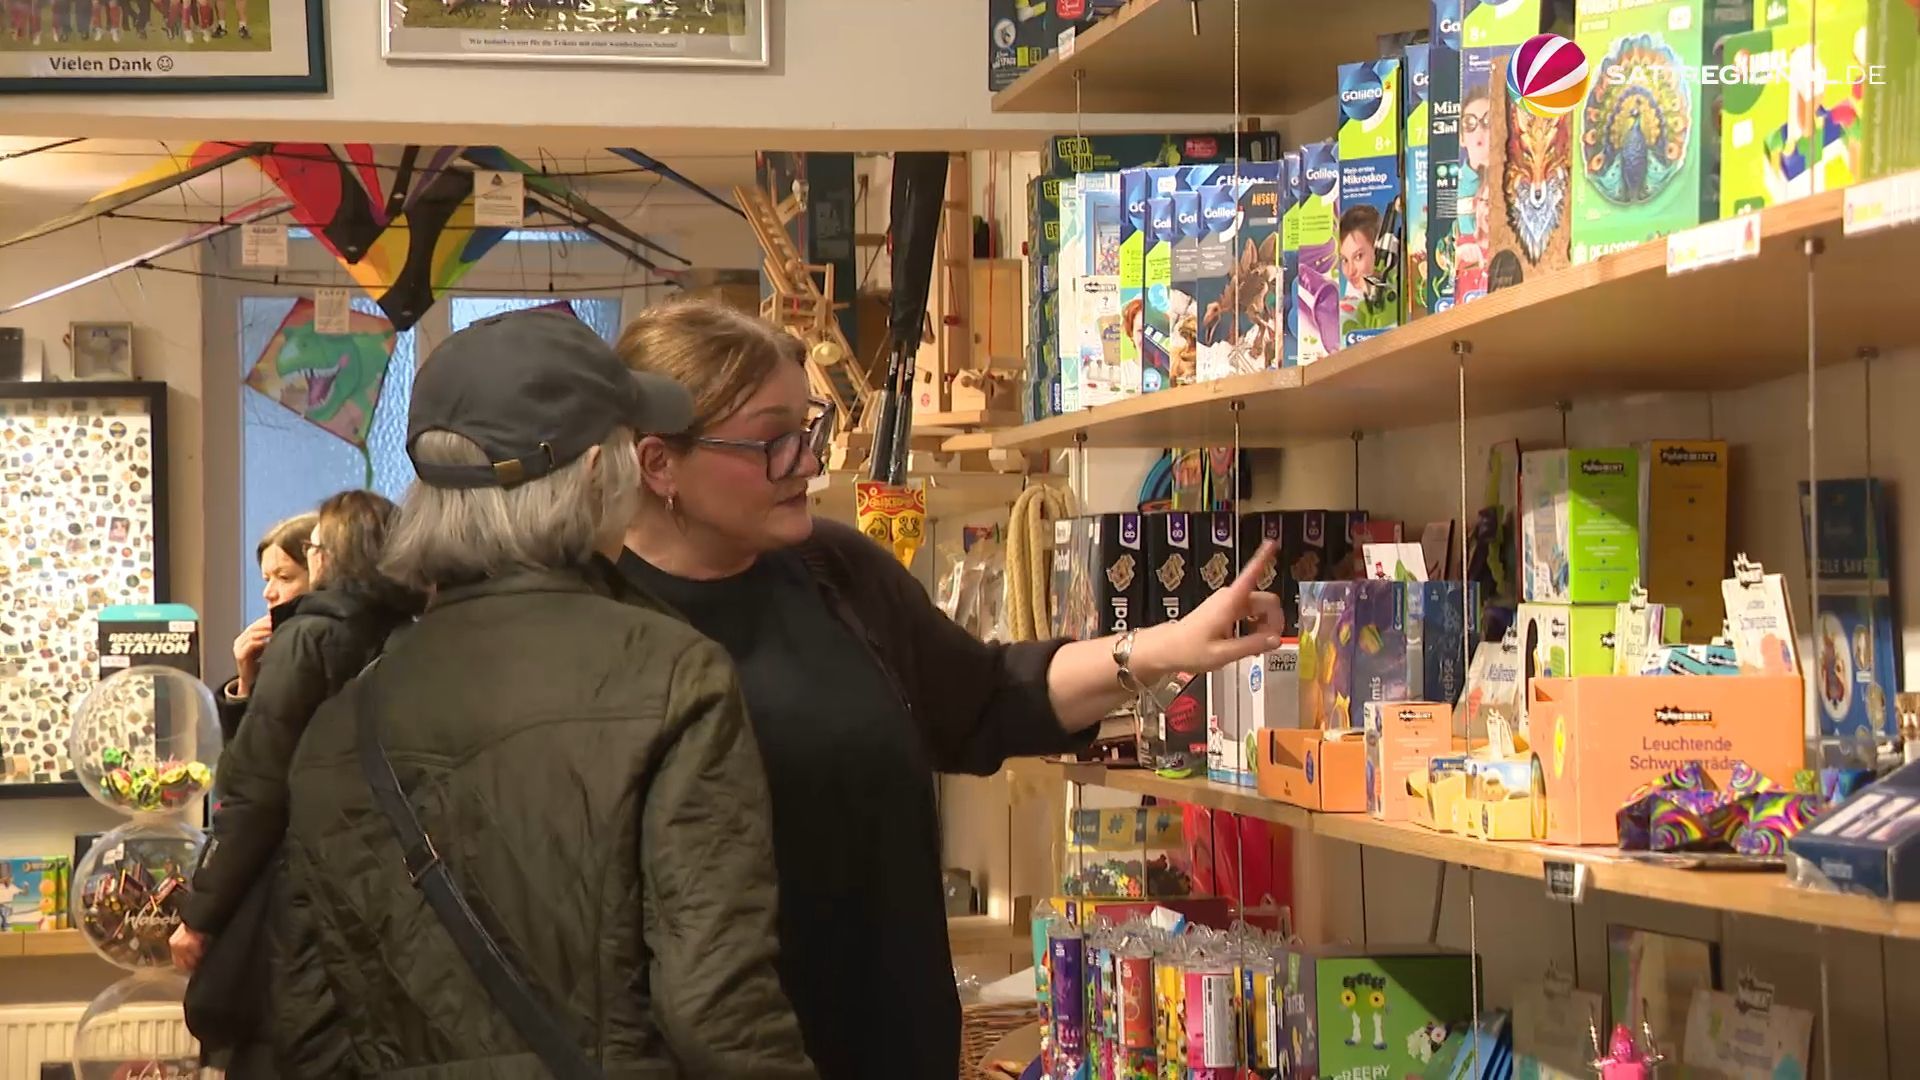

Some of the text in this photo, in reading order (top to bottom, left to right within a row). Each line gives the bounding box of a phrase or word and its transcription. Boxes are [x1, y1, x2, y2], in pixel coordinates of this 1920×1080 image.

[49, 57, 152, 71] Vielen Dank
[1341, 87, 1383, 103] Galileo
[1059, 140, 1088, 156] GECO
[1374, 136, 1392, 151] 8+
[1306, 168, 1339, 181] Galileo
[1342, 173, 1388, 186] Mikroskop
[1204, 206, 1237, 219] Galileo
[108, 632, 190, 643] RECREATION
[109, 642, 191, 655] STATION
[1642, 736, 1732, 751] Leuchtende
